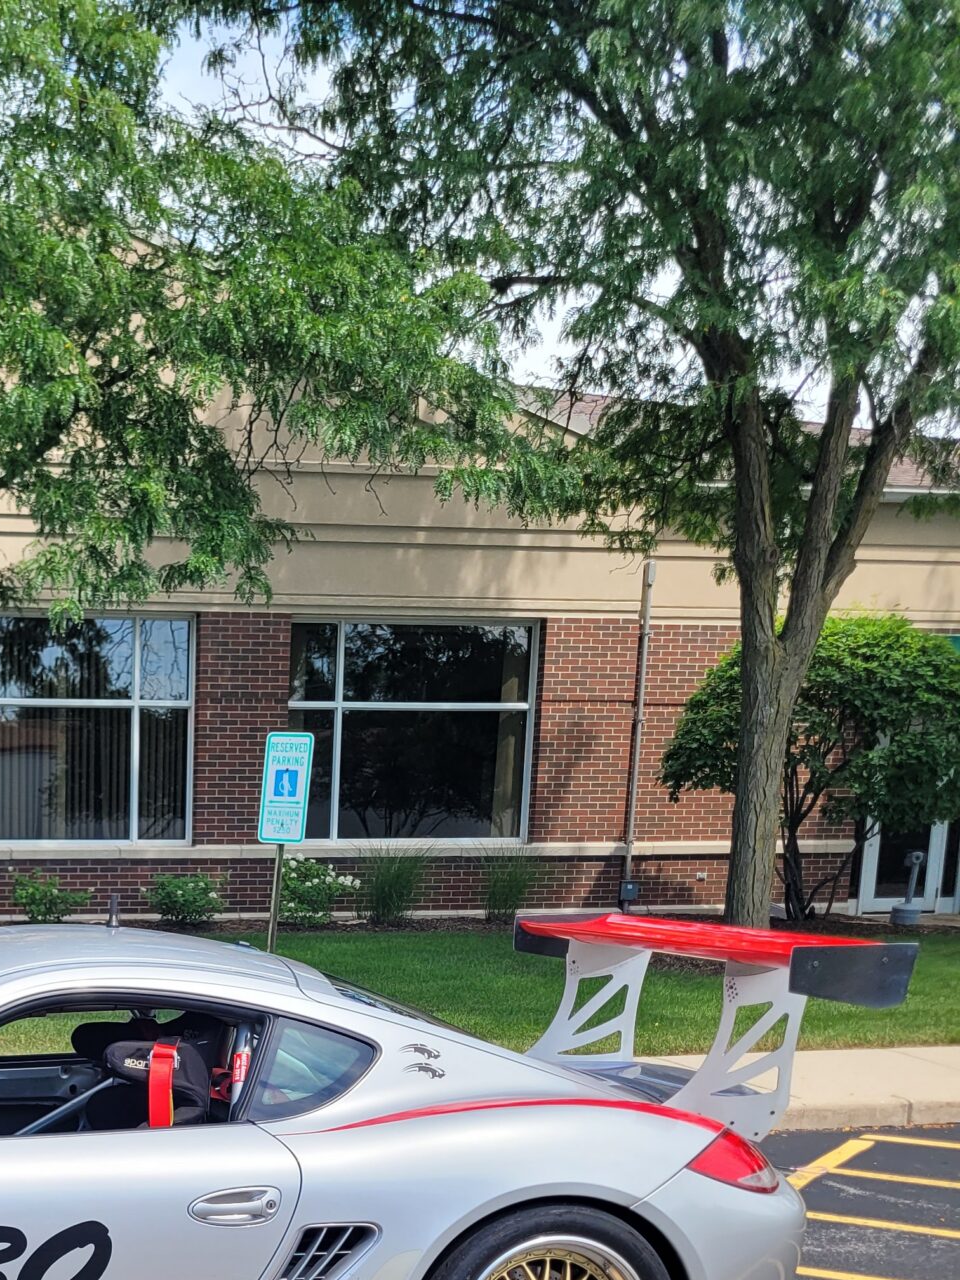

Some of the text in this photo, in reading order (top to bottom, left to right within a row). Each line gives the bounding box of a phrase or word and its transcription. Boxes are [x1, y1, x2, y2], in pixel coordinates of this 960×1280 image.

[271, 742, 308, 753] RESERVED
[272, 755, 304, 767] PARKING
[267, 809, 299, 817] MAXIMUM
[266, 817, 298, 826] PENALTY
[124, 1058, 149, 1069] spar
